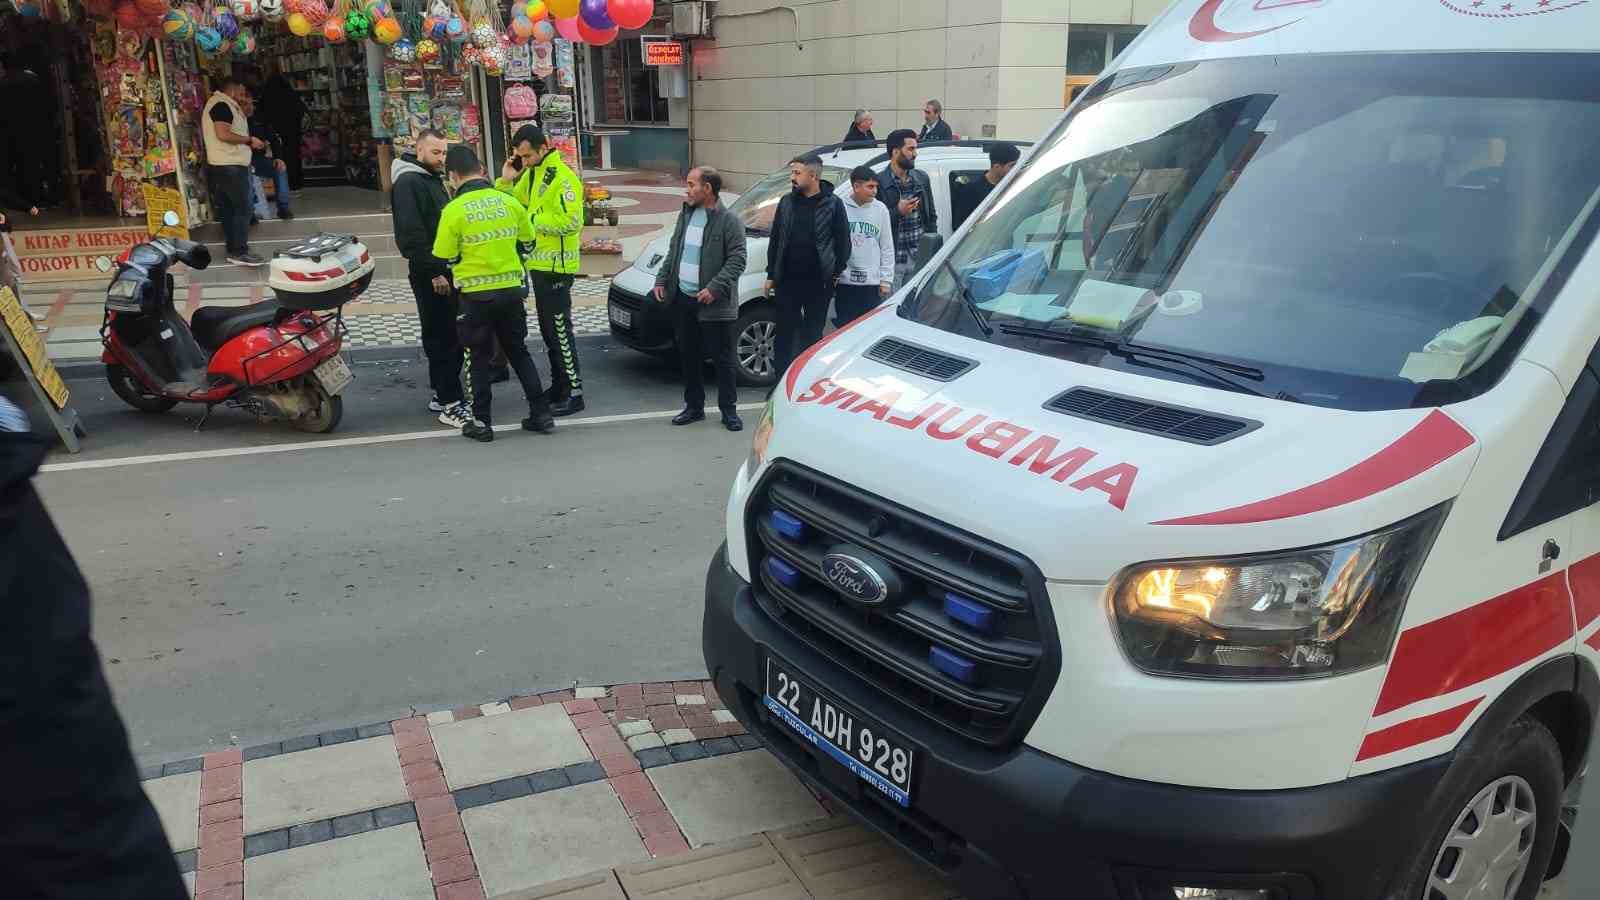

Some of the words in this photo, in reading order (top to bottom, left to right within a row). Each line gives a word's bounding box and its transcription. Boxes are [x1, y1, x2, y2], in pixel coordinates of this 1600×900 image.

[18, 256, 80, 273] TOKOPI
[829, 560, 866, 594] Ford
[776, 671, 801, 714] 22
[810, 697, 853, 752] ADH
[858, 728, 907, 784] 928
